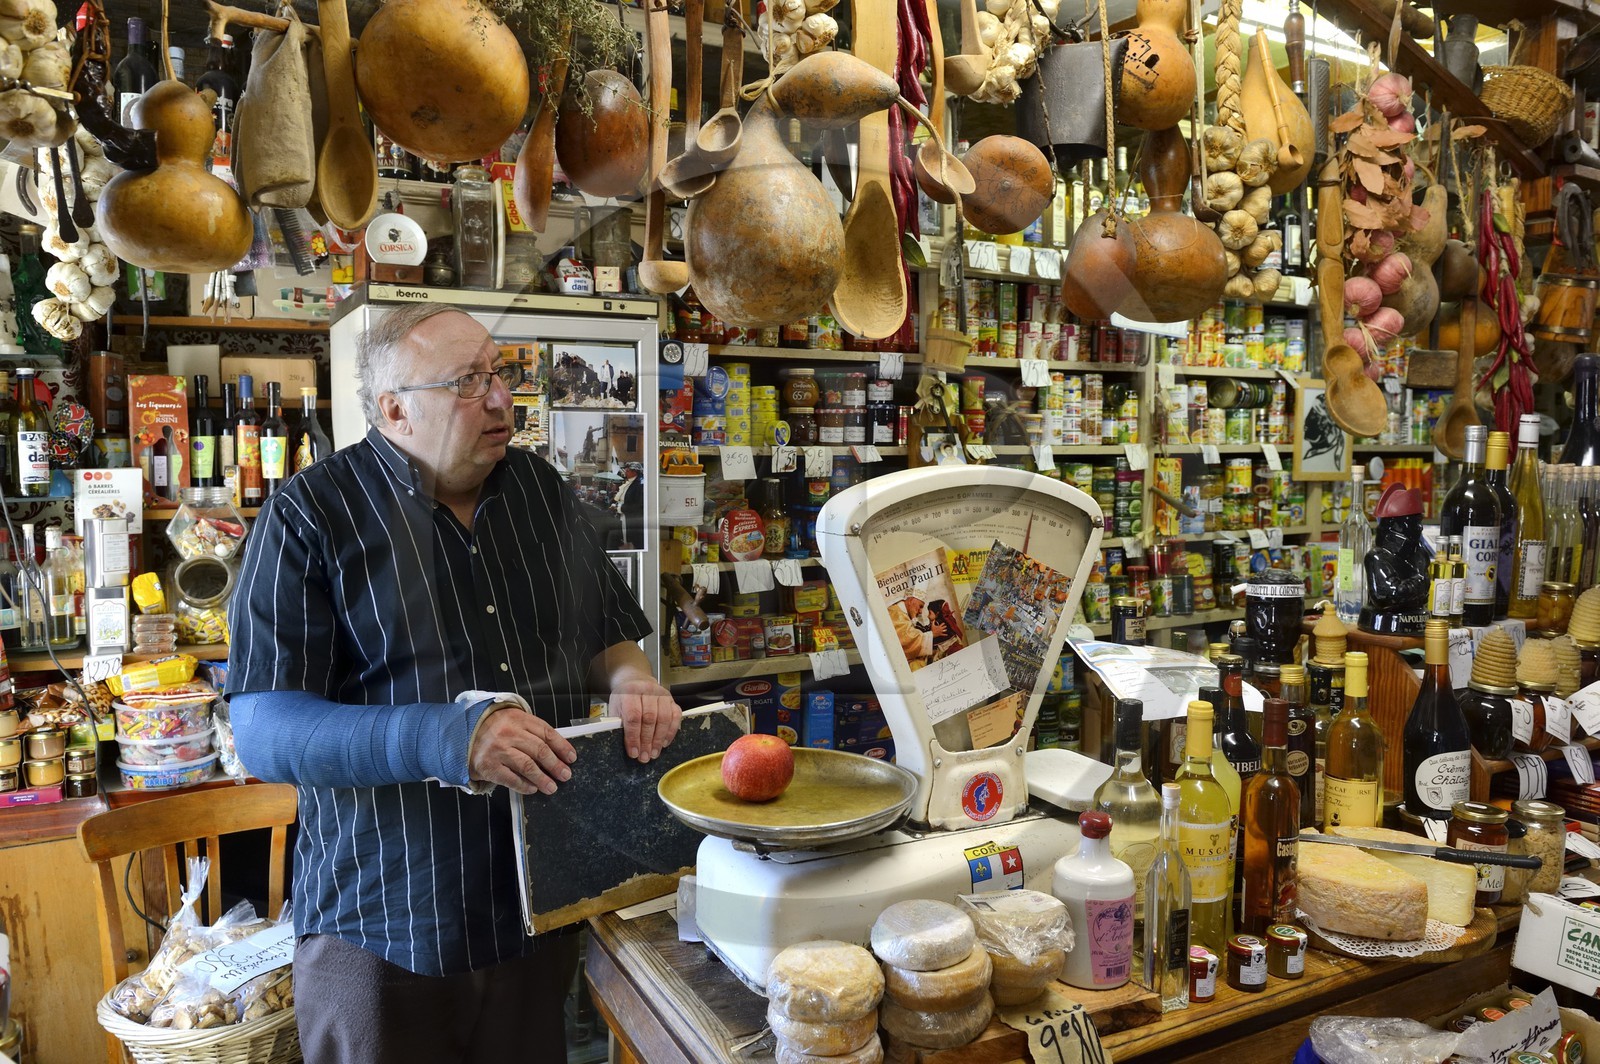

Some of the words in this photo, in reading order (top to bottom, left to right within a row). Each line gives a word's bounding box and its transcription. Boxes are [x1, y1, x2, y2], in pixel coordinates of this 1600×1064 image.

[508, 199, 520, 225] Gibbs
[379, 243, 413, 253] CORSICA
[396, 289, 428, 299] iberna
[149, 401, 175, 410] liqueurs
[685, 497, 698, 508] SEL
[932, 511, 941, 519] 700
[732, 522, 758, 534] EXPRESS
[722, 518, 730, 552] Casino
[877, 562, 928, 589] Bienheureux
[884, 579, 910, 598] Jean
[910, 566, 934, 586] Paul
[935, 562, 945, 576] II
[814, 627, 833, 637] KUB
[818, 636, 834, 644] OR
[743, 682, 770, 693] Barilla
[1437, 763, 1466, 774] Crème
[145, 777, 173, 787] HARIBO
